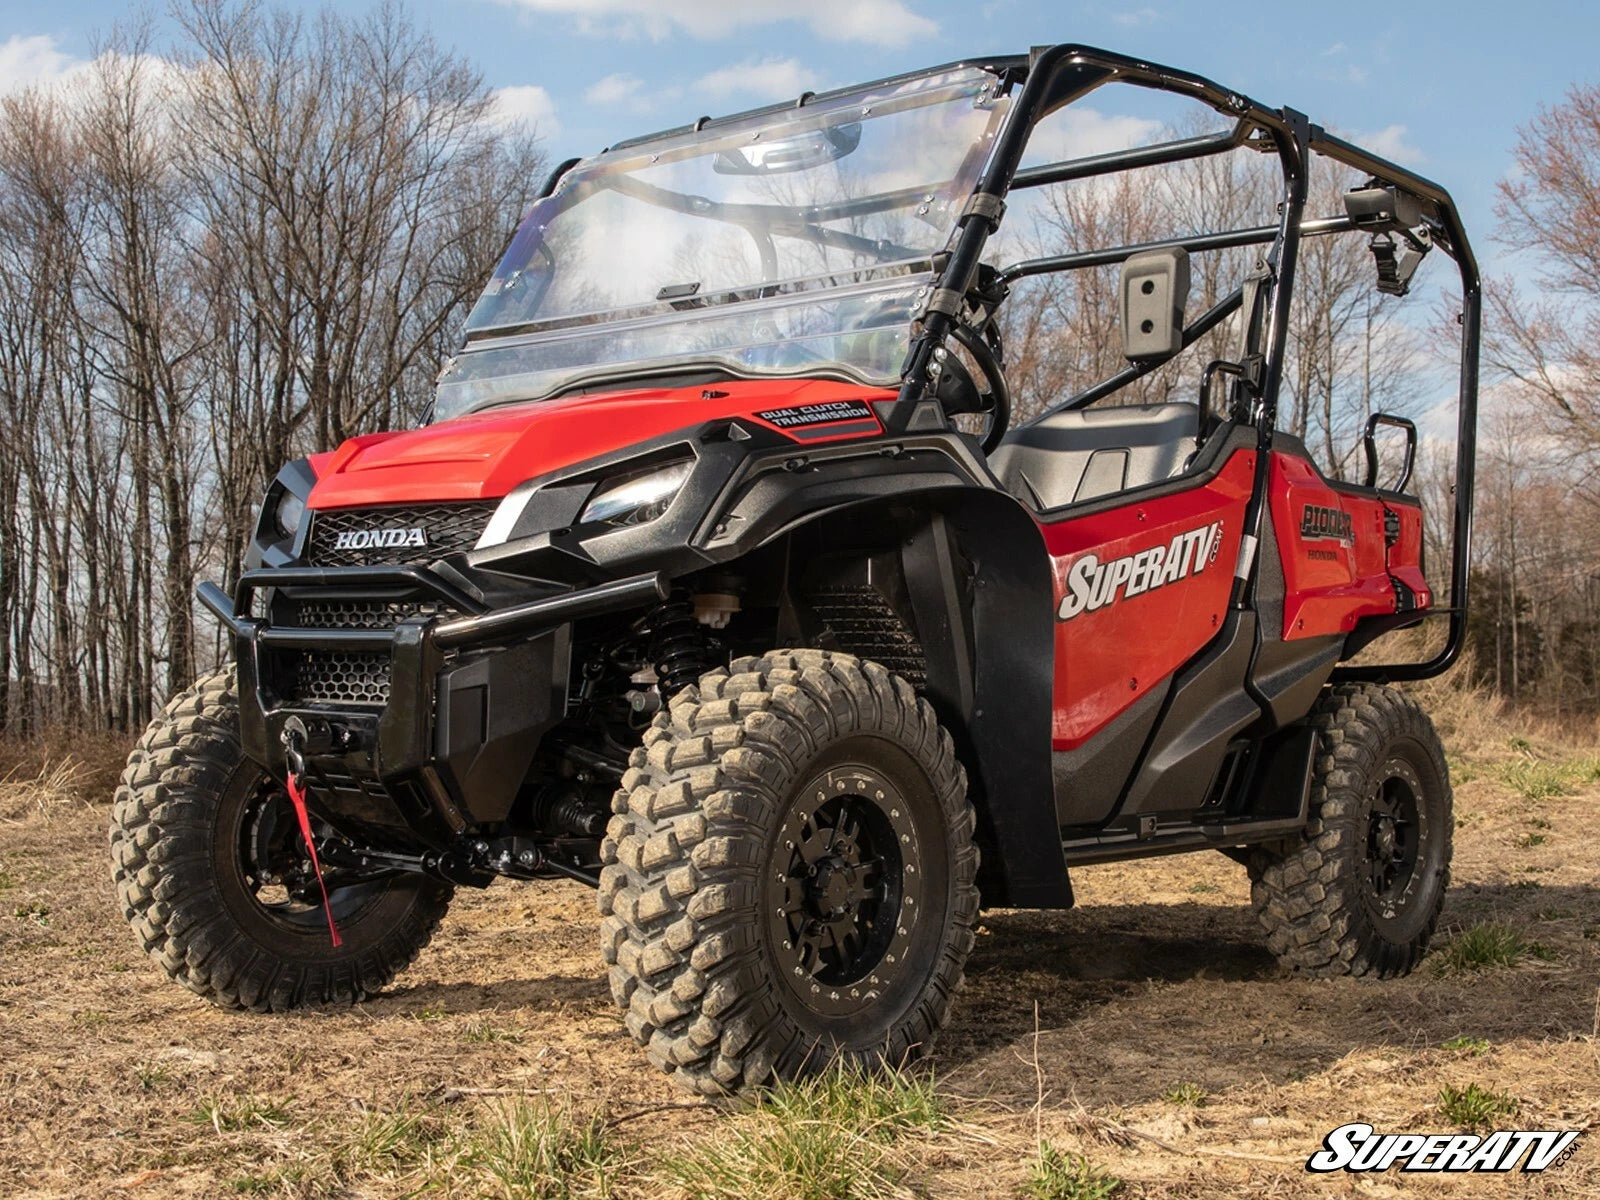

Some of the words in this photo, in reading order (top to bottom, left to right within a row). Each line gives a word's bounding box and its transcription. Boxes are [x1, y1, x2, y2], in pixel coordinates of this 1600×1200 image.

[760, 408, 798, 420] DUAL
[800, 401, 852, 414] CLUTCH
[771, 407, 871, 427] TRANSMISSION
[334, 528, 427, 550] HONDA
[1308, 549, 1338, 561] HONDA
